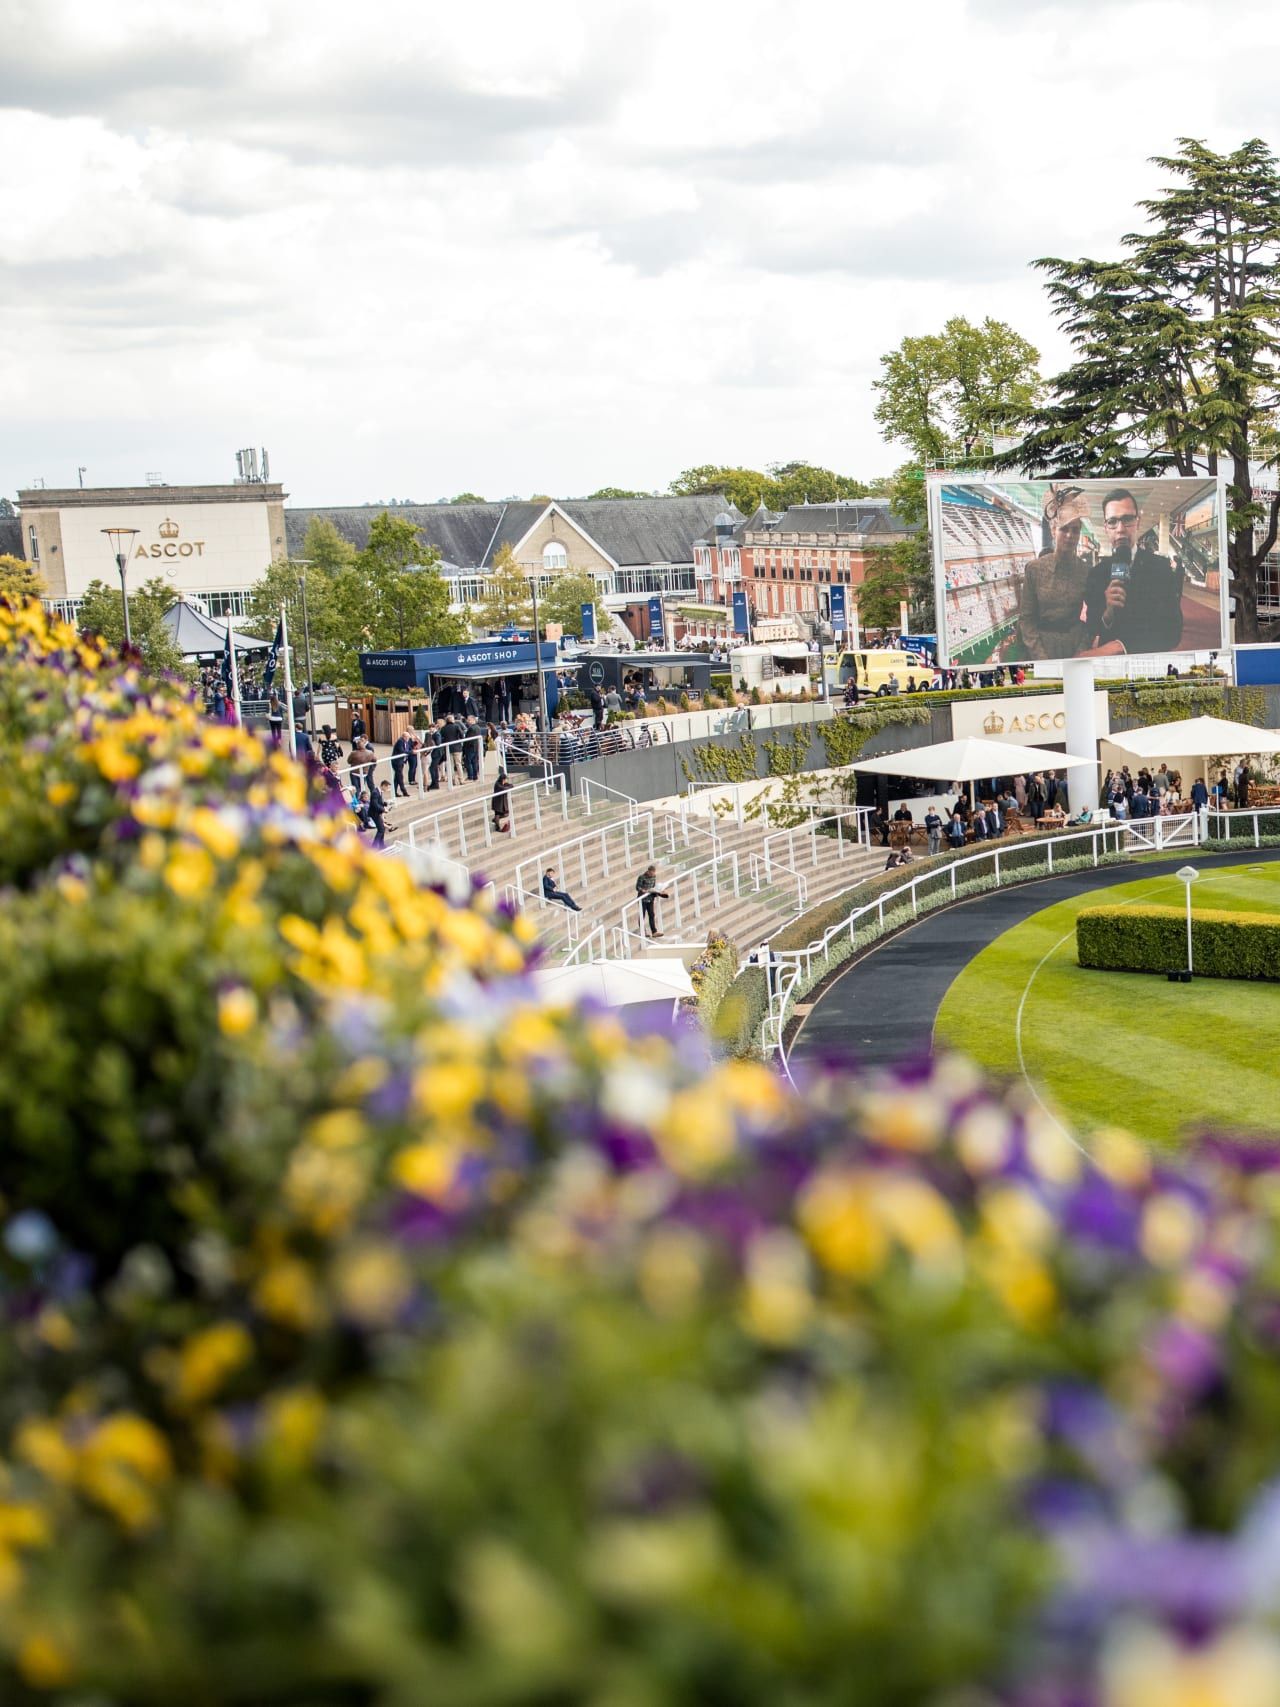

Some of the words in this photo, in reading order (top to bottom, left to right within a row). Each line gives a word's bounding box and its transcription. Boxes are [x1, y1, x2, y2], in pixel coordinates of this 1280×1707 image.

[134, 542, 205, 559] ASCOT
[466, 652, 492, 663] ASCOT
[494, 650, 517, 660] SHOP
